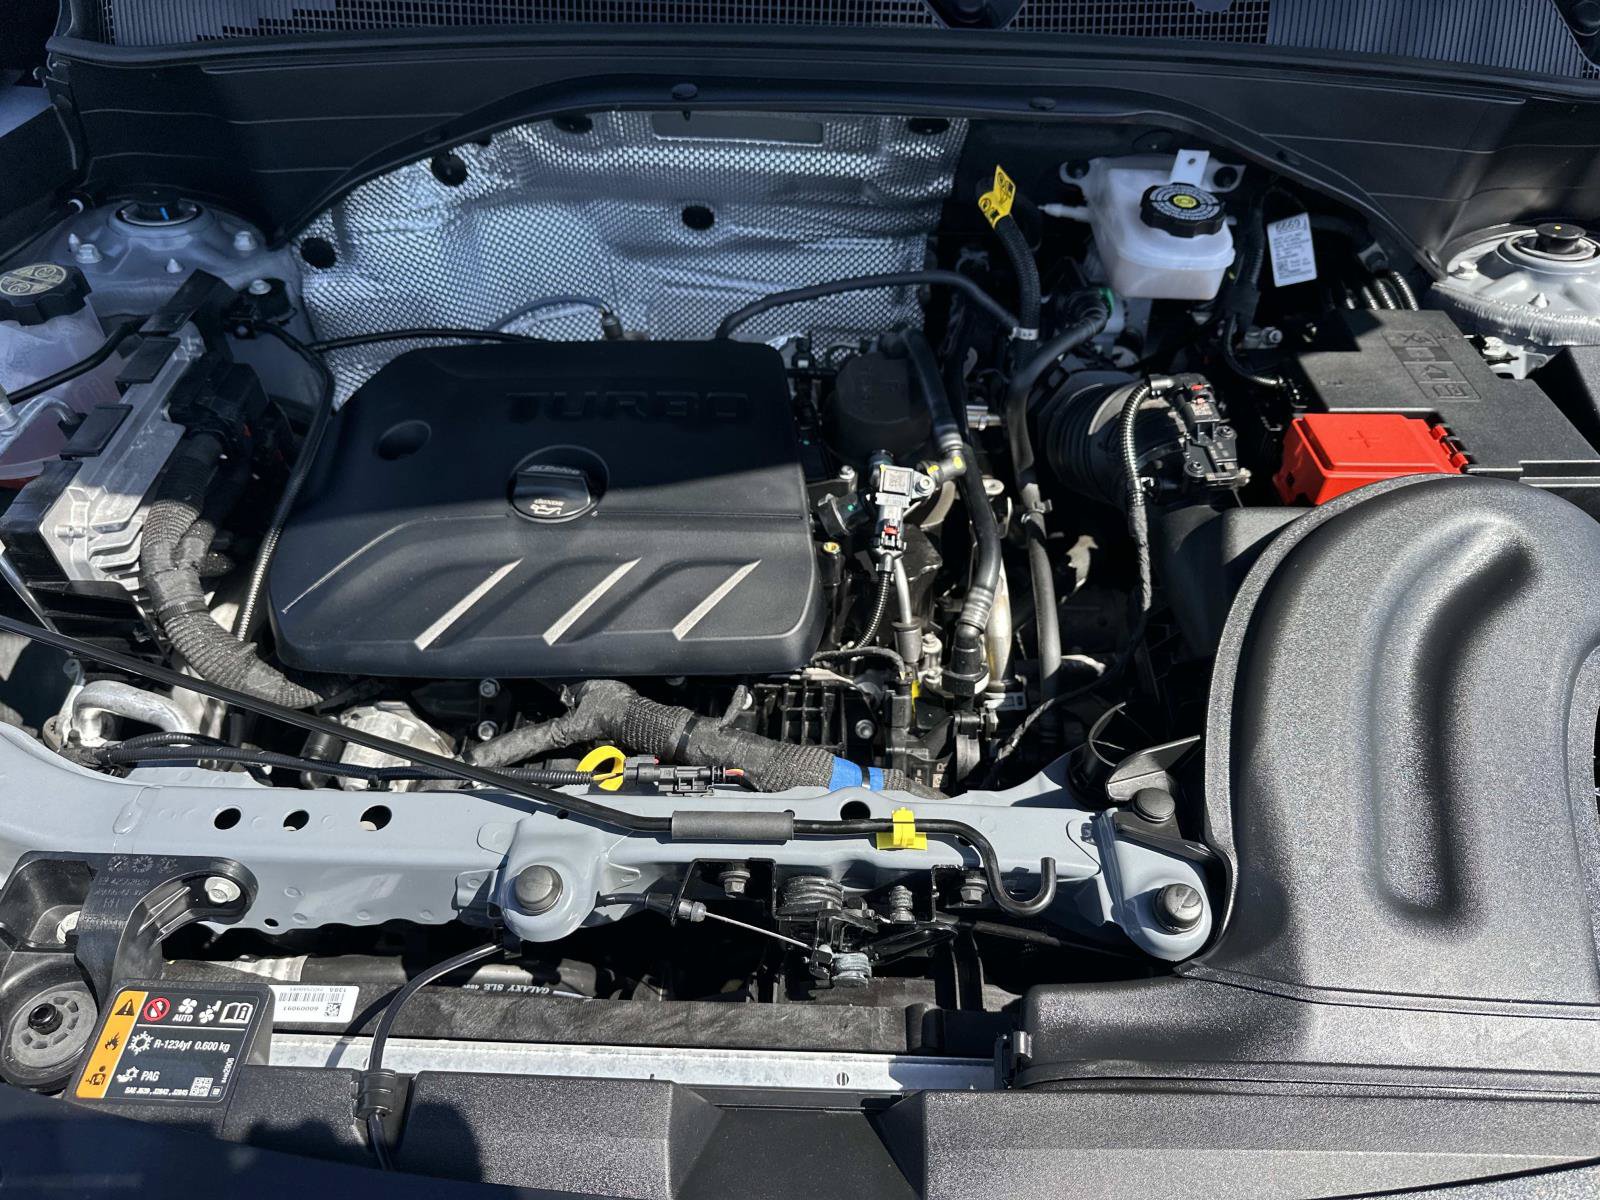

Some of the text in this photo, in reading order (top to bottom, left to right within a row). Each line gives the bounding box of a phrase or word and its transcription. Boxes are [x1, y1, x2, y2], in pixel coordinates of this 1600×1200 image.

[505, 391, 750, 419] TURBO
[483, 983, 504, 991] SLE
[507, 984, 550, 995] GALAXY
[172, 1013, 194, 1023] AUTO
[153, 1039, 231, 1053] R-1234yf 0.600 kg
[140, 1070, 160, 1081] PAG
